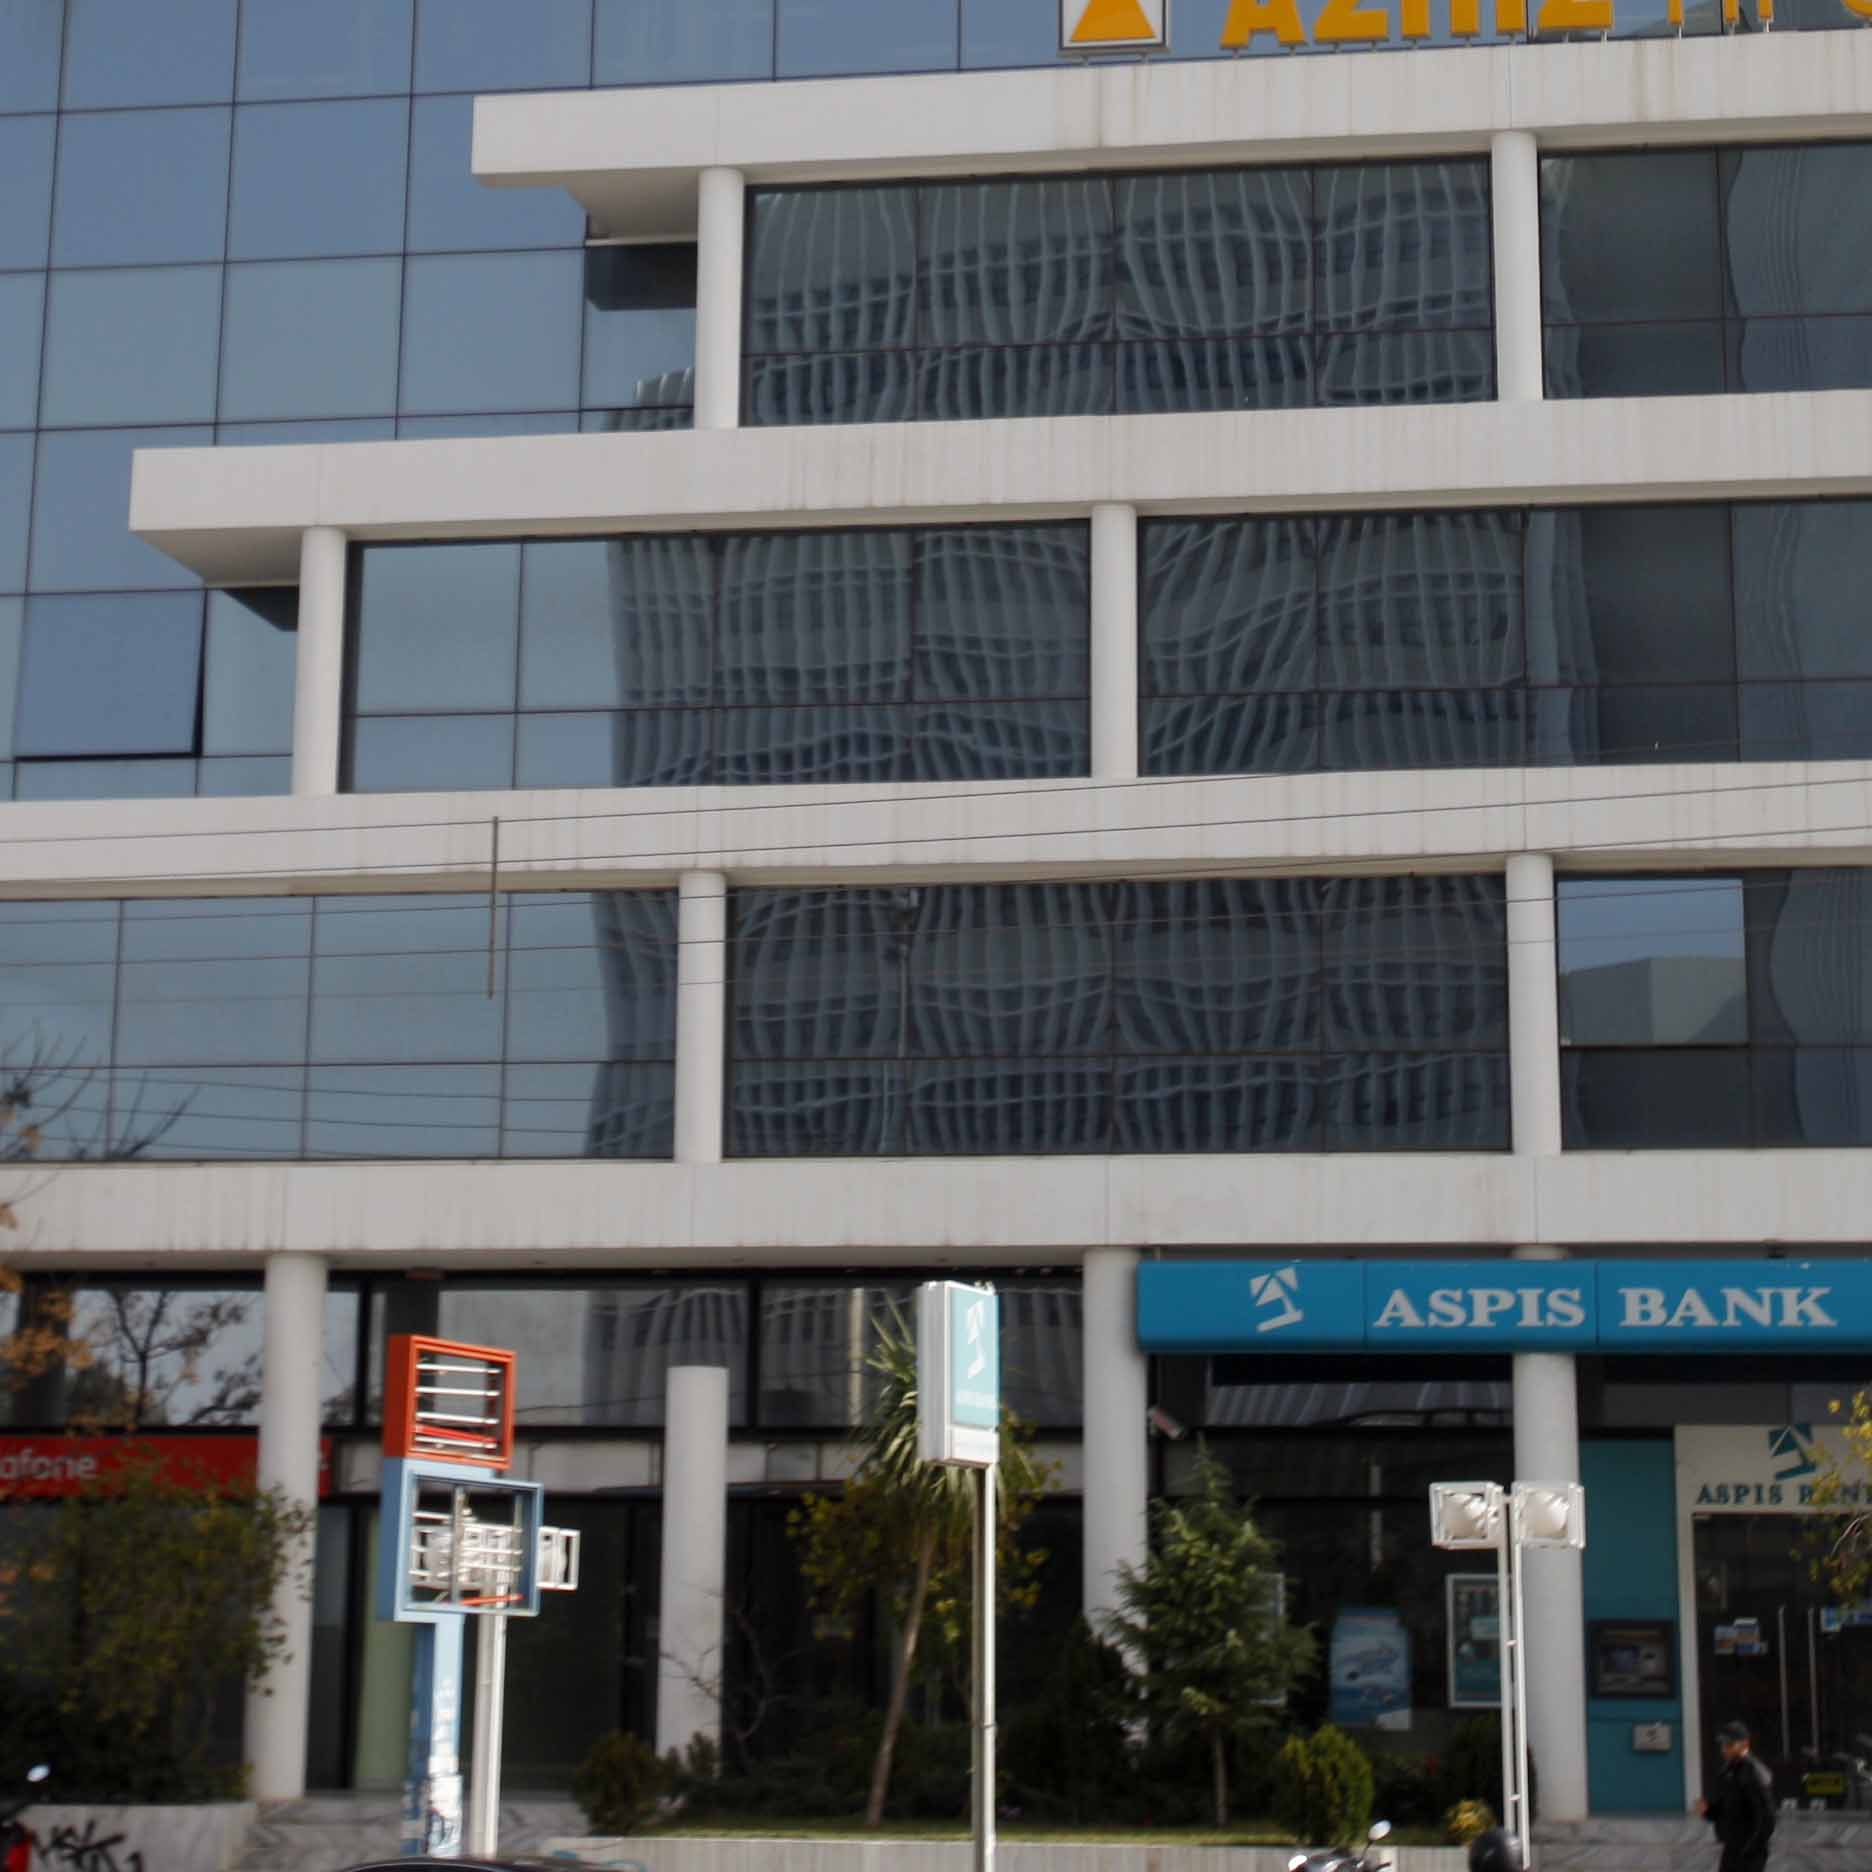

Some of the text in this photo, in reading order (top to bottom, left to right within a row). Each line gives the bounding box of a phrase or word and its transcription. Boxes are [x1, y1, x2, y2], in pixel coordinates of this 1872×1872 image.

[1373, 1286, 1837, 1328] ASPIS BANK
[1696, 1483, 1784, 1505] ASPIS
